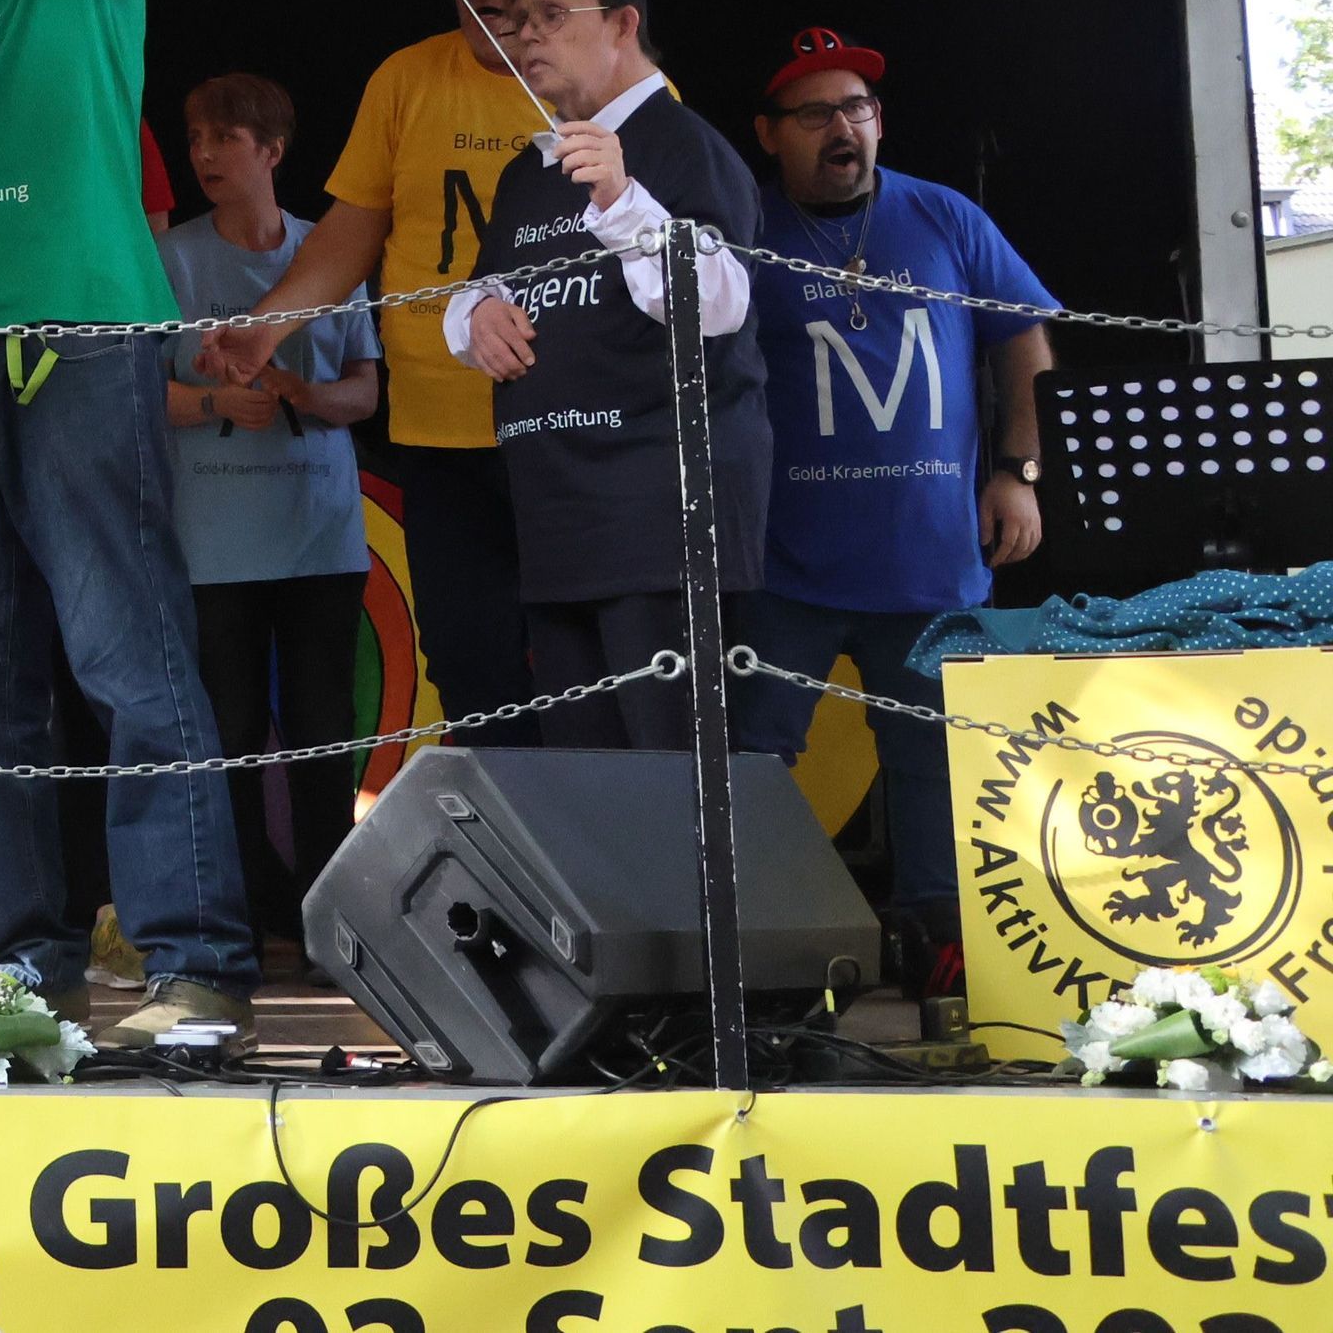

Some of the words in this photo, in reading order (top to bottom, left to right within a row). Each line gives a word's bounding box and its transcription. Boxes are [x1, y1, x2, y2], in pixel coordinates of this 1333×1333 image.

[513, 270, 602, 323] rigent
[805, 308, 943, 436] M
[789, 460, 961, 482] Gold-Kraemer-Stiftung
[30, 1142, 592, 1270] Großes
[637, 1143, 1333, 1285] Stadtfes
